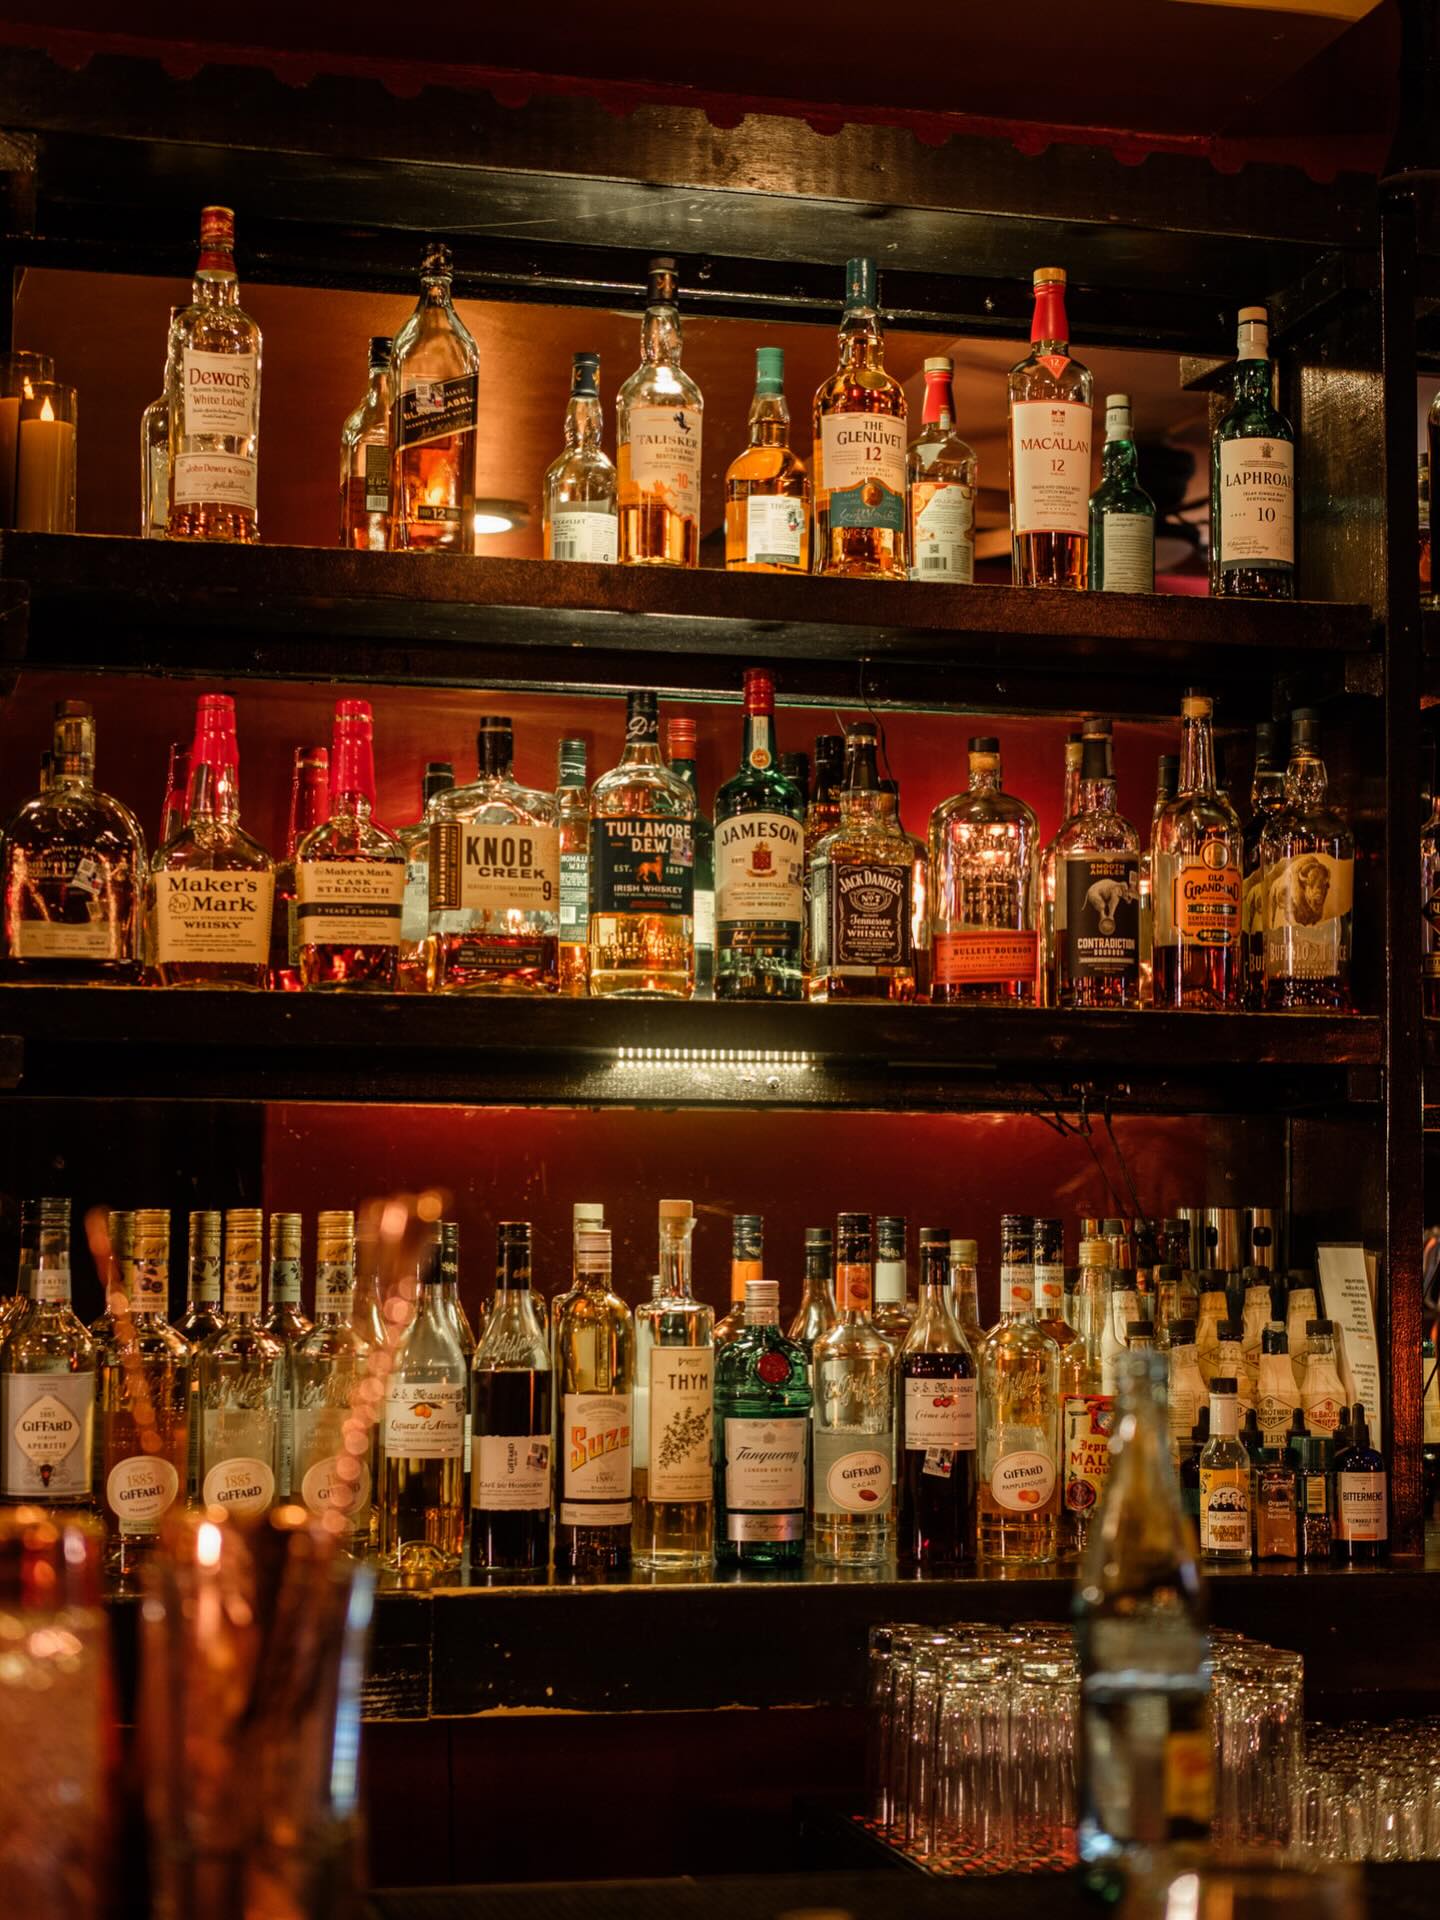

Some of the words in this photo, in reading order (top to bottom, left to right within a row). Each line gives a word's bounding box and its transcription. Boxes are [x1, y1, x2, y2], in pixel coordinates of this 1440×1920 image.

[189, 368, 250, 390] Dewar's
[444, 387, 467, 397] ALKER
[193, 394, 219, 405] White
[222, 395, 246, 408] Label
[444, 395, 473, 409] ABEL
[864, 421, 883, 432] THE
[636, 434, 699, 449] TALISKER
[837, 431, 902, 449] GLENLIVET
[1021, 437, 1089, 453] MACALLAN
[865, 447, 882, 461] 12
[1051, 459, 1065, 472] 12
[677, 472, 689, 489] 10
[1226, 471, 1293, 489] LAPHROAI
[432, 508, 446, 519] 12
[1258, 507, 1276, 522] 10
[605, 821, 691, 839] TULLAMORE
[721, 821, 799, 846] JAMESON
[466, 836, 533, 867] KNOB
[632, 838, 669, 854] D.E.W.
[325, 868, 364, 877] Maker's
[366, 868, 393, 877] Mark
[478, 867, 545, 879] CREEK
[614, 864, 632, 873] EST.
[168, 877, 258, 893] Maker's
[317, 886, 390, 894] STRENGTH
[542, 880, 552, 901] 9
[613, 884, 640, 892] IRISH
[642, 885, 683, 894] WHISKEY
[840, 873, 865, 894] JACK
[864, 870, 904, 896] DANIEL'S
[192, 896, 256, 912] Mark
[184, 921, 241, 929] WHISKY
[847, 929, 895, 938] WHISKEY
[953, 947, 991, 956] BULLEIT
[1077, 938, 1136, 950] CONTRADICTION
[668, 1373, 708, 1390] THYM
[22, 1420, 73, 1432] GIFFARD
[1264, 1433, 1286, 1443] LERY
[1079, 1439, 1108, 1453] Jepp
[507, 1442, 515, 1474] GIFFARD
[735, 1446, 800, 1464] Tanqueray
[1071, 1451, 1112, 1466] MAL
[842, 1465, 882, 1480] GIFFARD
[1003, 1465, 1043, 1480] GIFFARD
[1083, 1466, 1112, 1475] LIQU
[127, 1472, 154, 1488] 1885
[224, 1472, 252, 1489] 1885
[852, 1481, 877, 1489] CACAO
[1001, 1477, 1048, 1492] PAMPLEMOUSSE
[119, 1485, 165, 1501] GIFFARD
[216, 1485, 262, 1503] GIFFARD
